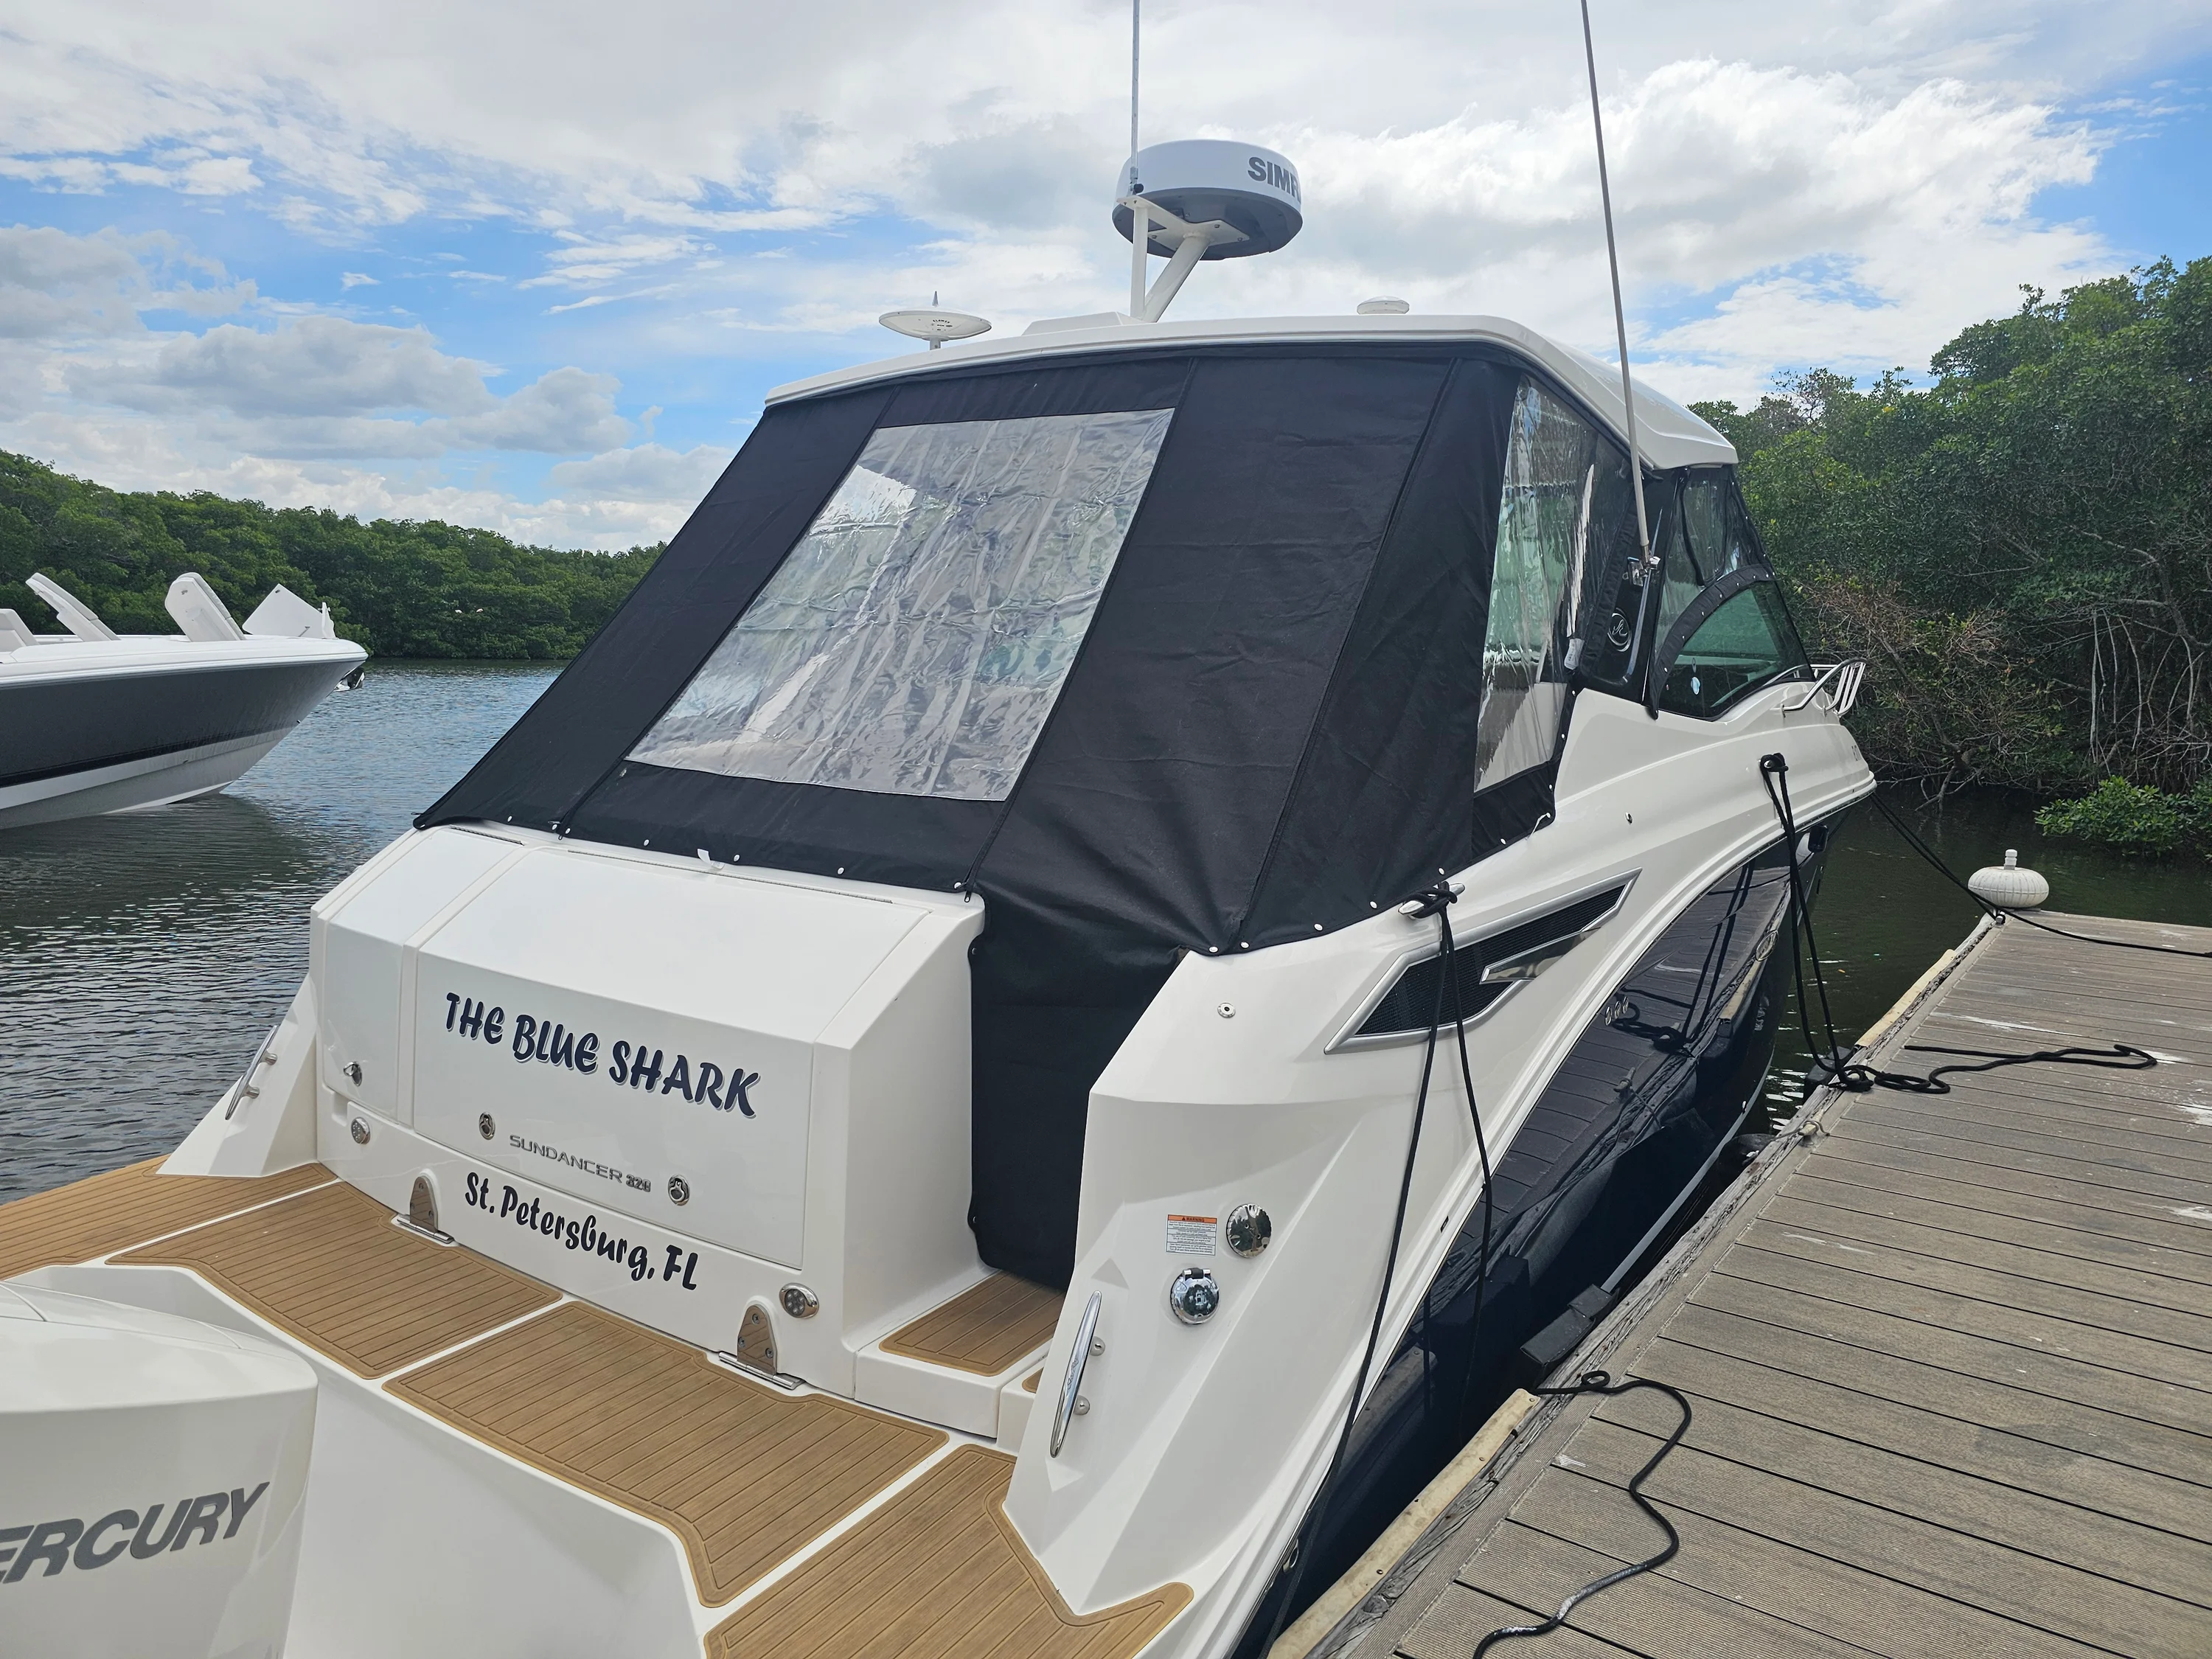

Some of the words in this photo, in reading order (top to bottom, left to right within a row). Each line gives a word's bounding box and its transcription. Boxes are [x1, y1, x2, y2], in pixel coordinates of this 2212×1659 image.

[445, 992, 505, 1045] THE
[512, 1015, 599, 1074] BLUE
[609, 1040, 760, 1118] SHARK
[509, 1134, 623, 1184] SUNDANCER
[625, 1174, 652, 1193] 320
[465, 1172, 495, 1214] St.
[501, 1185, 655, 1281] Petersburg,
[663, 1244, 698, 1291] FL
